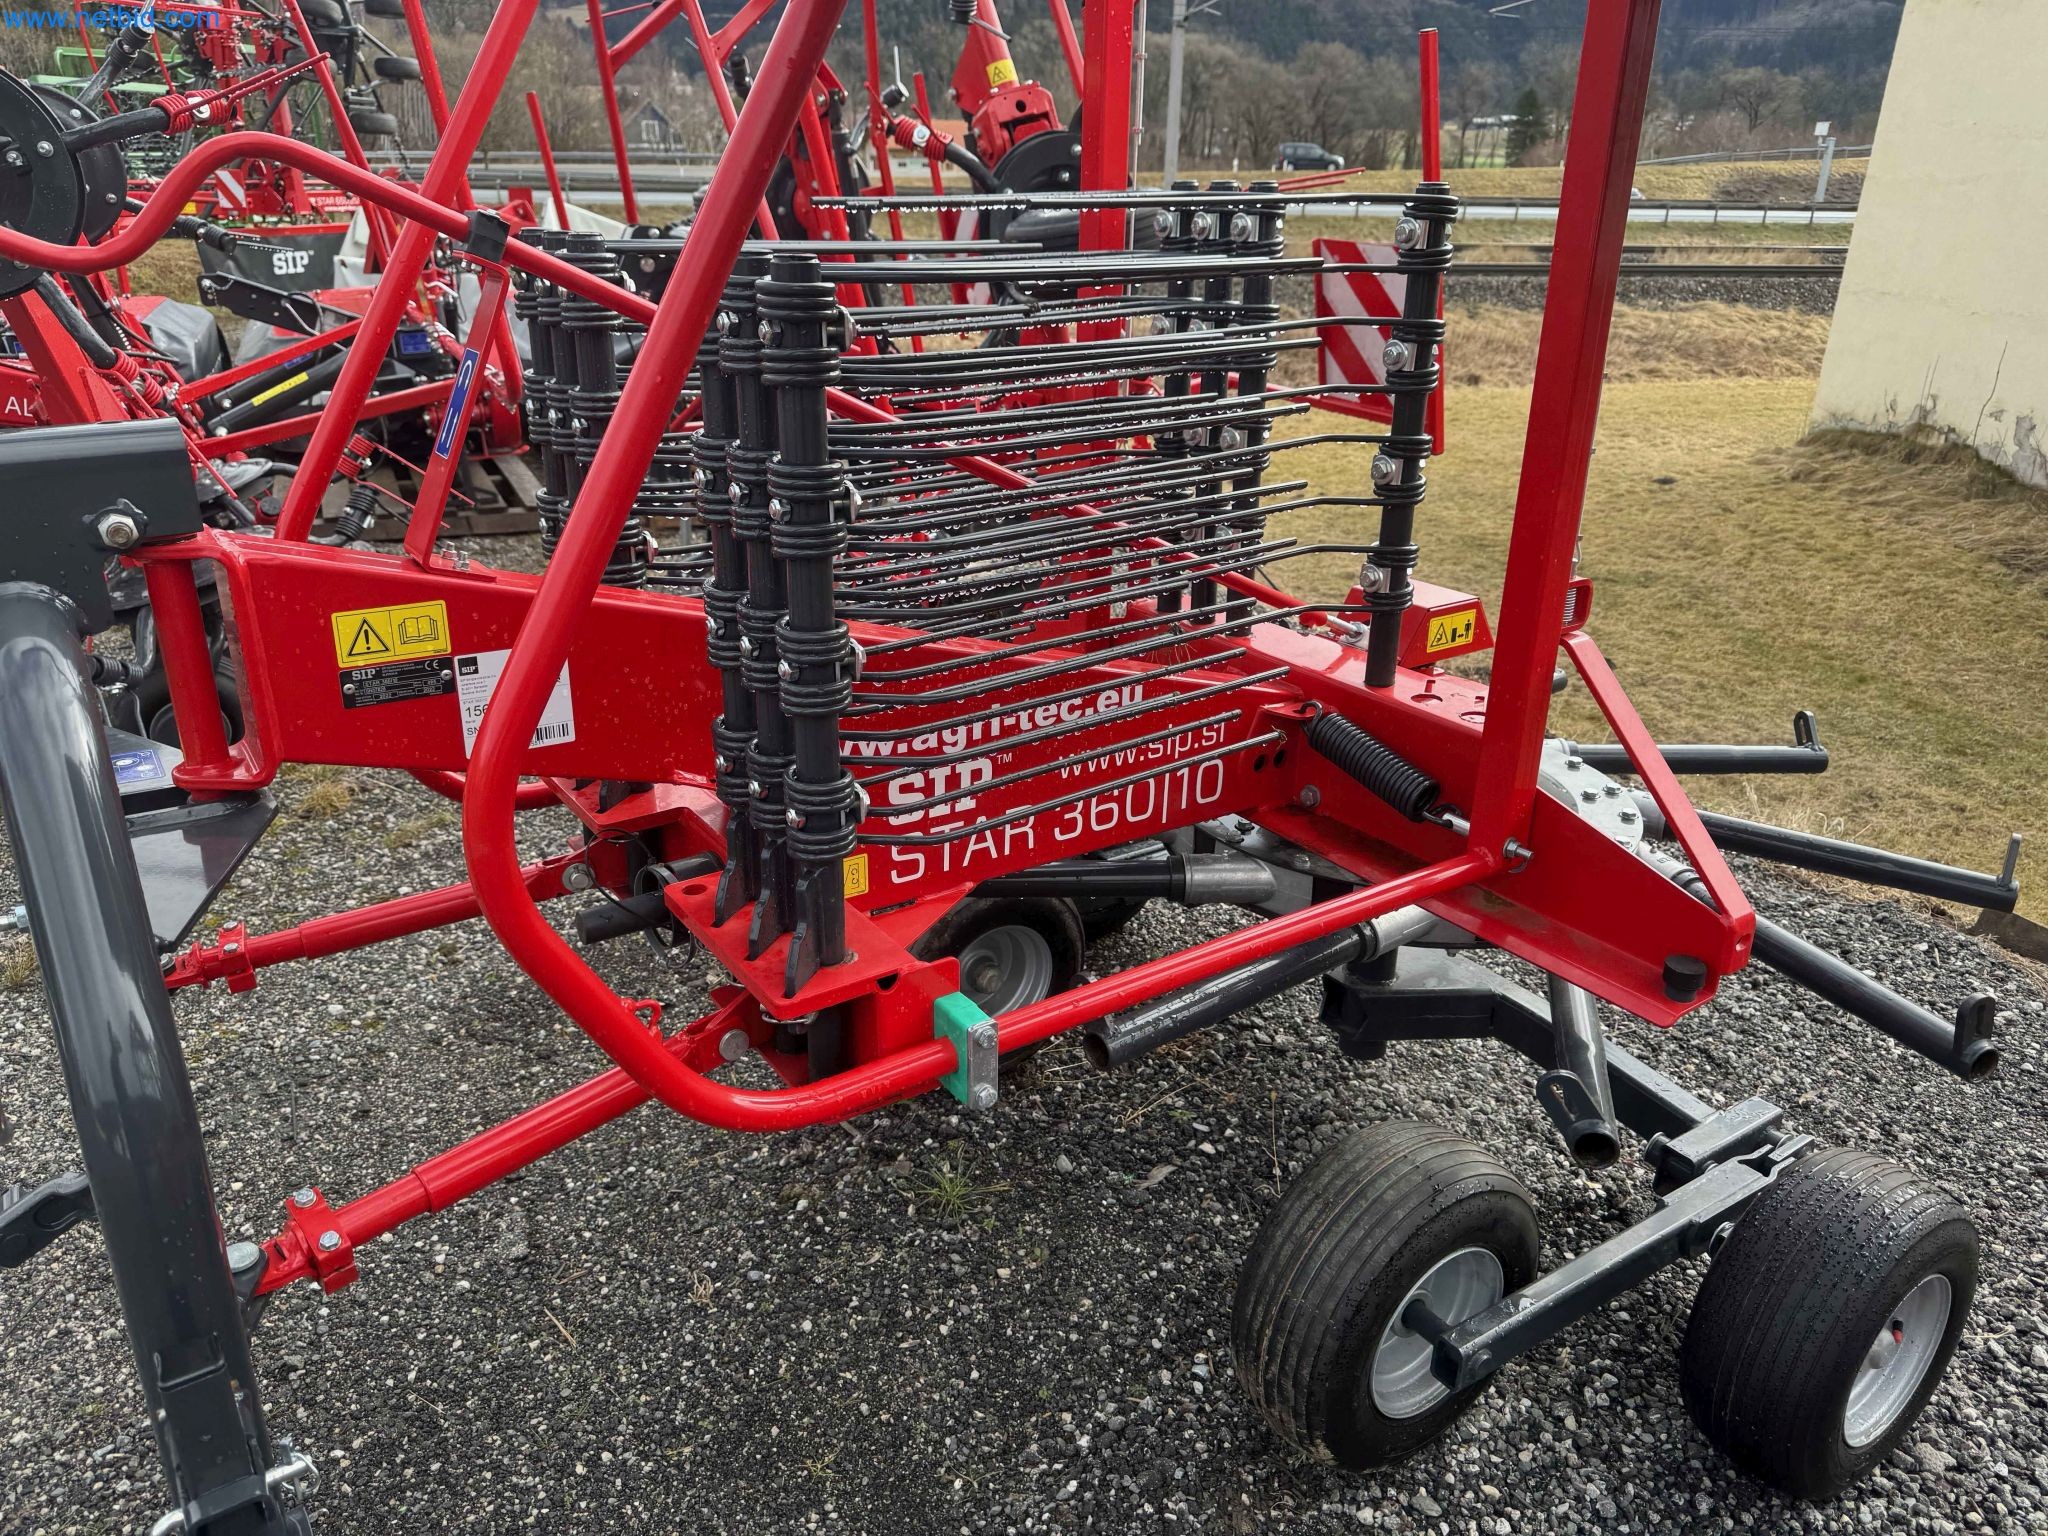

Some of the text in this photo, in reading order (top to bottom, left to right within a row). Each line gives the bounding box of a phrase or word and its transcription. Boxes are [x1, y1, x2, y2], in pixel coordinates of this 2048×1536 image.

[272, 250, 309, 275] SIP
[352, 668, 376, 681] SIP
[1058, 711, 1226, 780] www.sip.si
[887, 758, 994, 827] SIP
[890, 804, 1035, 885] STAR
